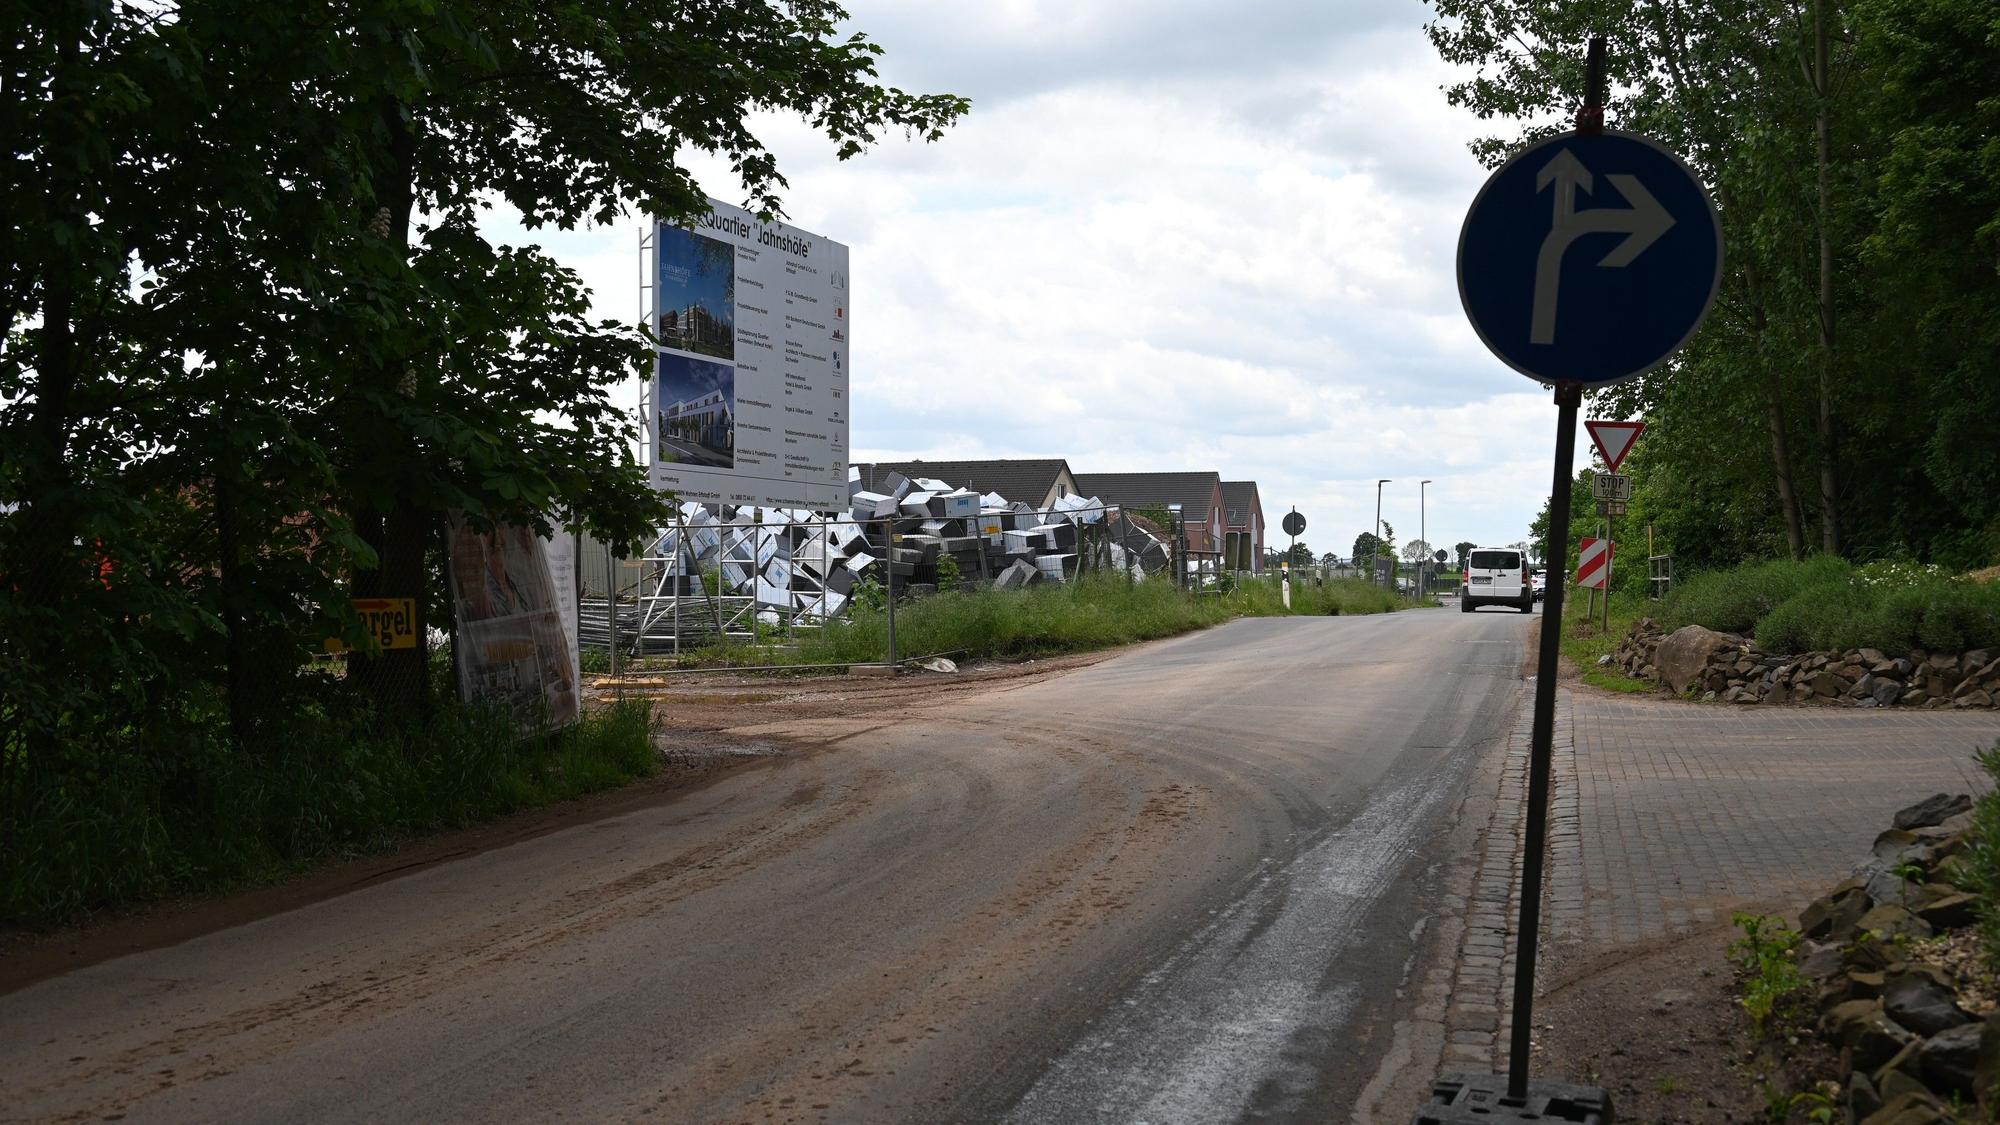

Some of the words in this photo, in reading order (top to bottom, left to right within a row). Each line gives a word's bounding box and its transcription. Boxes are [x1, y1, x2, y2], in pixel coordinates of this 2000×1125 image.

[706, 211, 750, 239] Quartier
[754, 222, 812, 258] "Jahnshöfe"
[1601, 477, 1624, 489] STOP
[358, 600, 412, 647] argel
